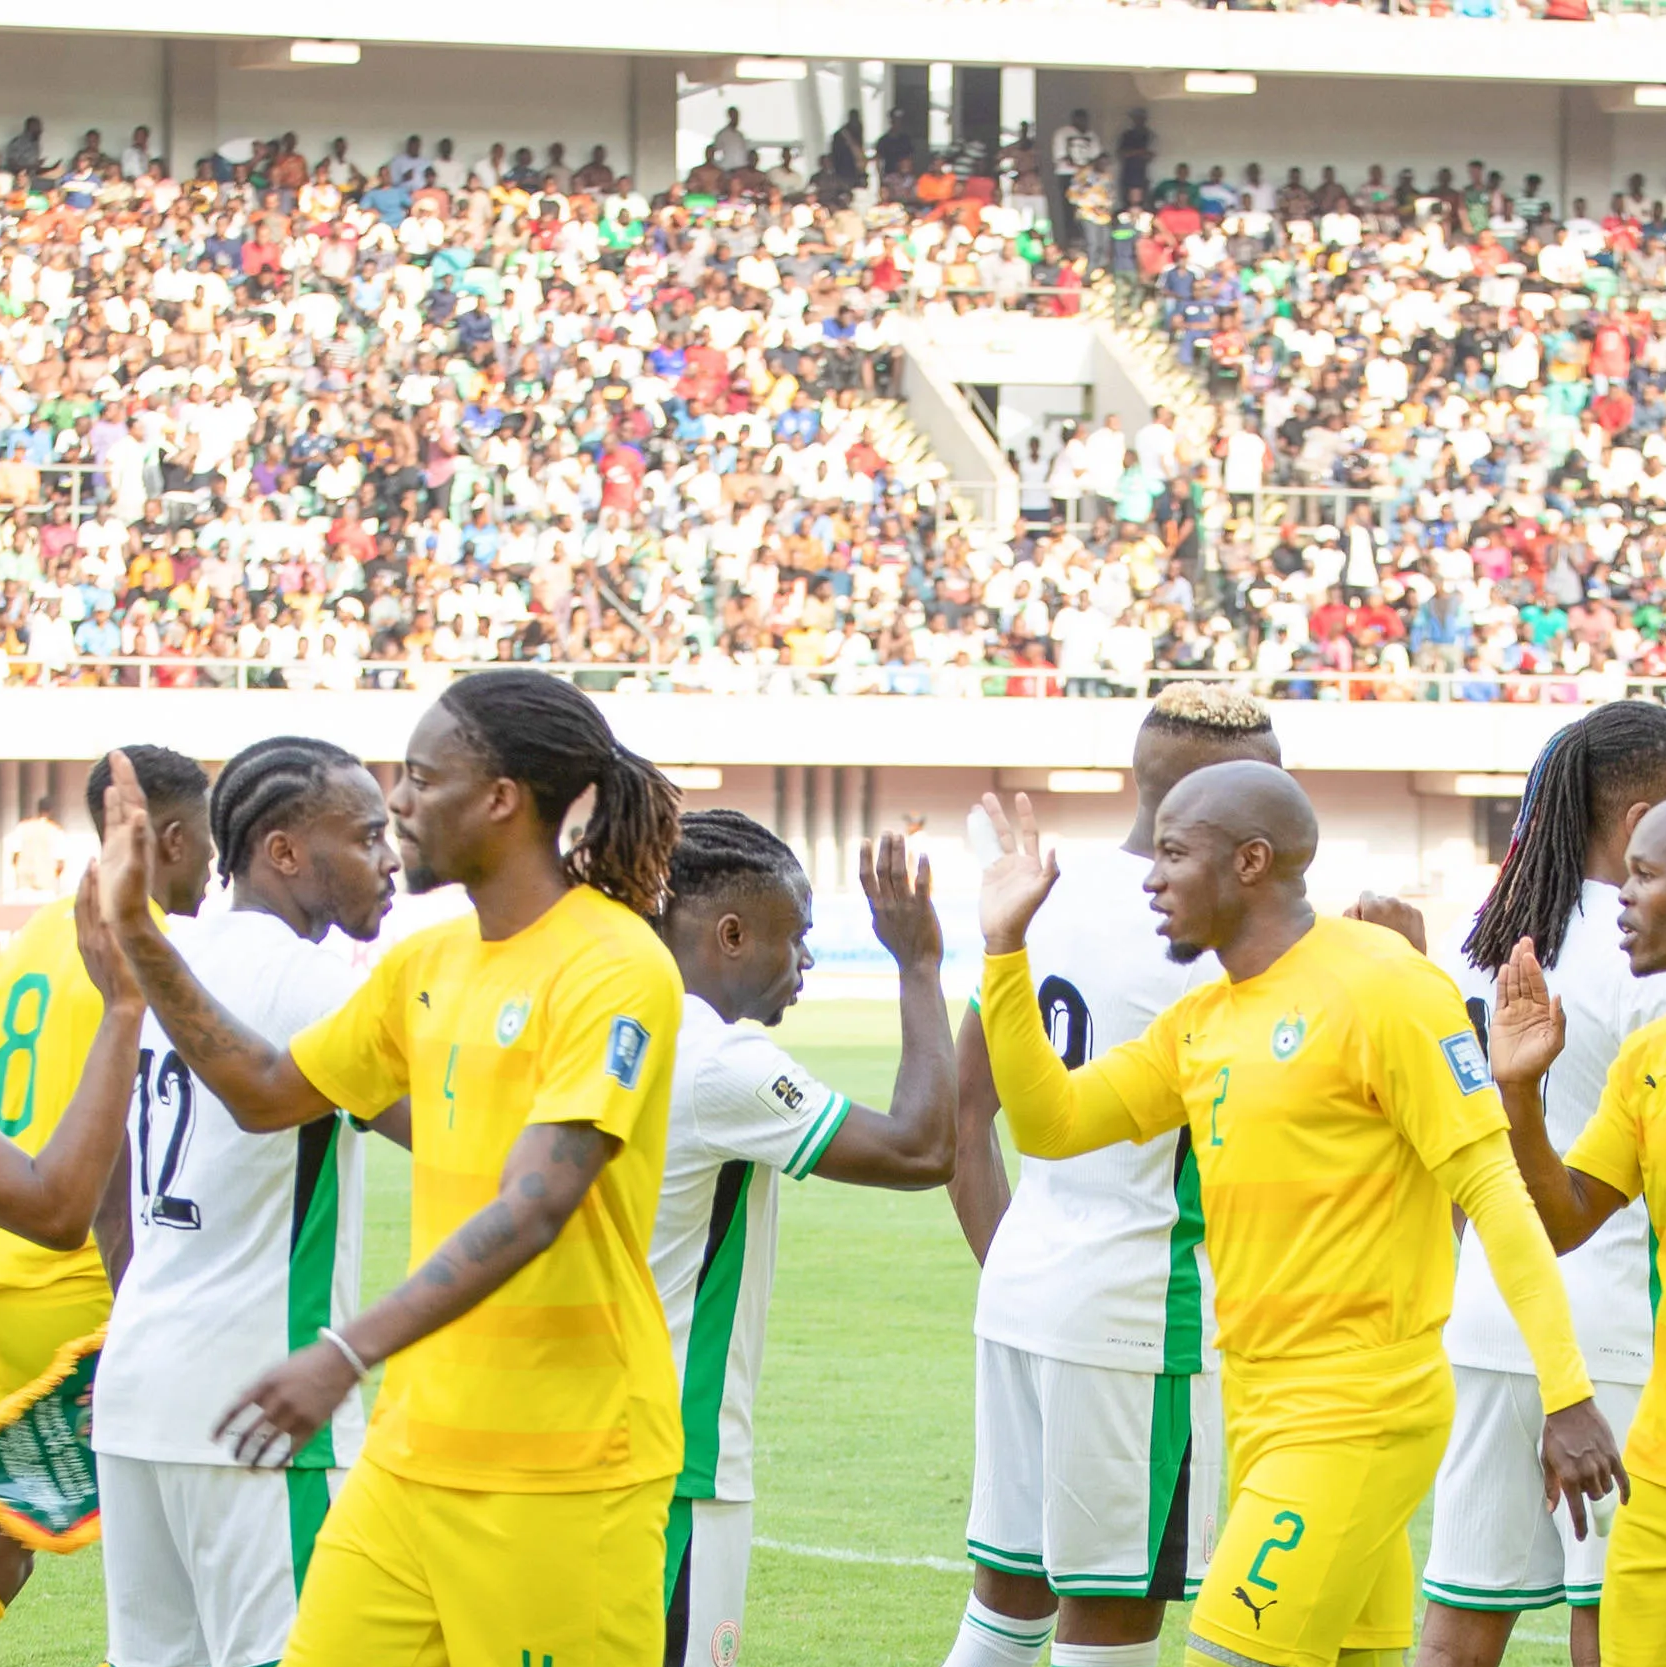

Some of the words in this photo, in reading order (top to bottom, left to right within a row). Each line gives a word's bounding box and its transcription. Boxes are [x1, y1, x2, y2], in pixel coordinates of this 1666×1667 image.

[131, 1048, 202, 1232] 12
[1210, 1066, 1231, 1148] 2
[1247, 1509, 1306, 1592] 2
